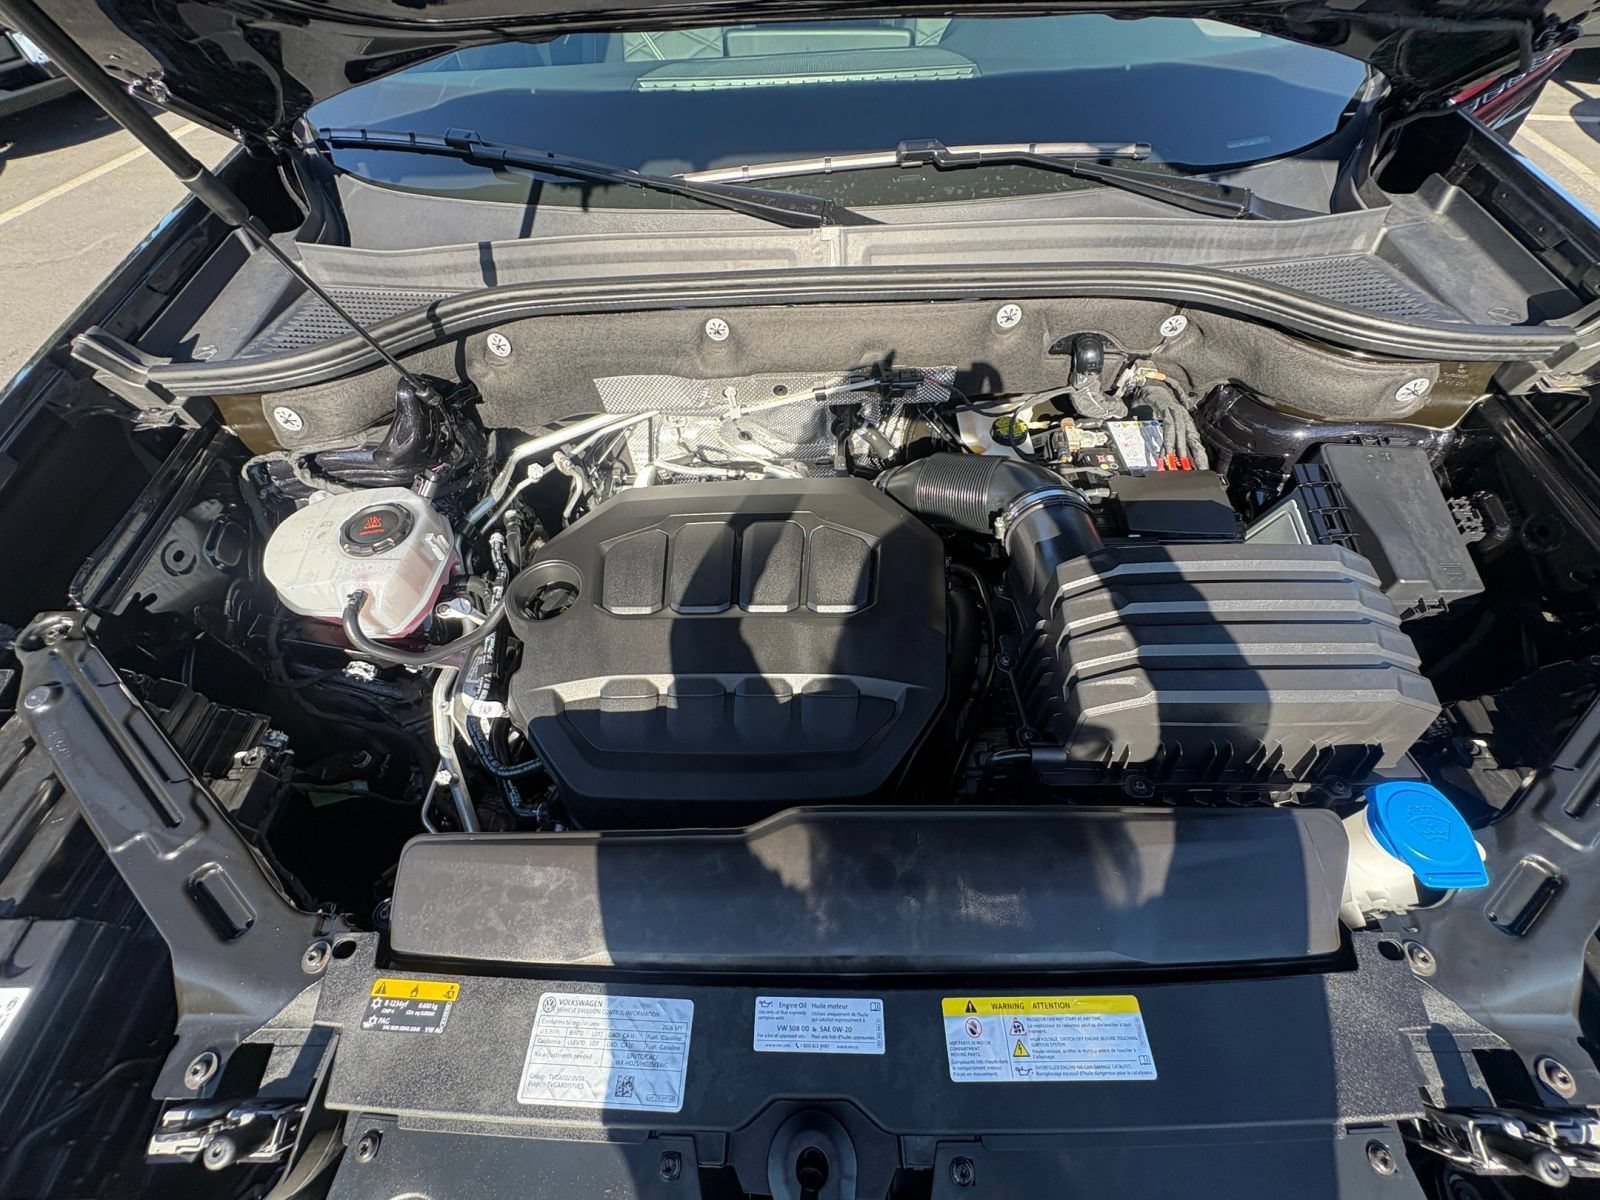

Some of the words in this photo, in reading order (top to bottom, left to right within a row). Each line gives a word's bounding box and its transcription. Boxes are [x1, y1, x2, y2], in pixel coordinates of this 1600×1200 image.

[559, 999, 603, 1007] VOLKSWAGEN
[779, 1002, 797, 1010] Engine
[991, 1002, 1024, 1010] WARNING
[1032, 1002, 1071, 1010] ATTENTION
[377, 1017, 391, 1025] PAG
